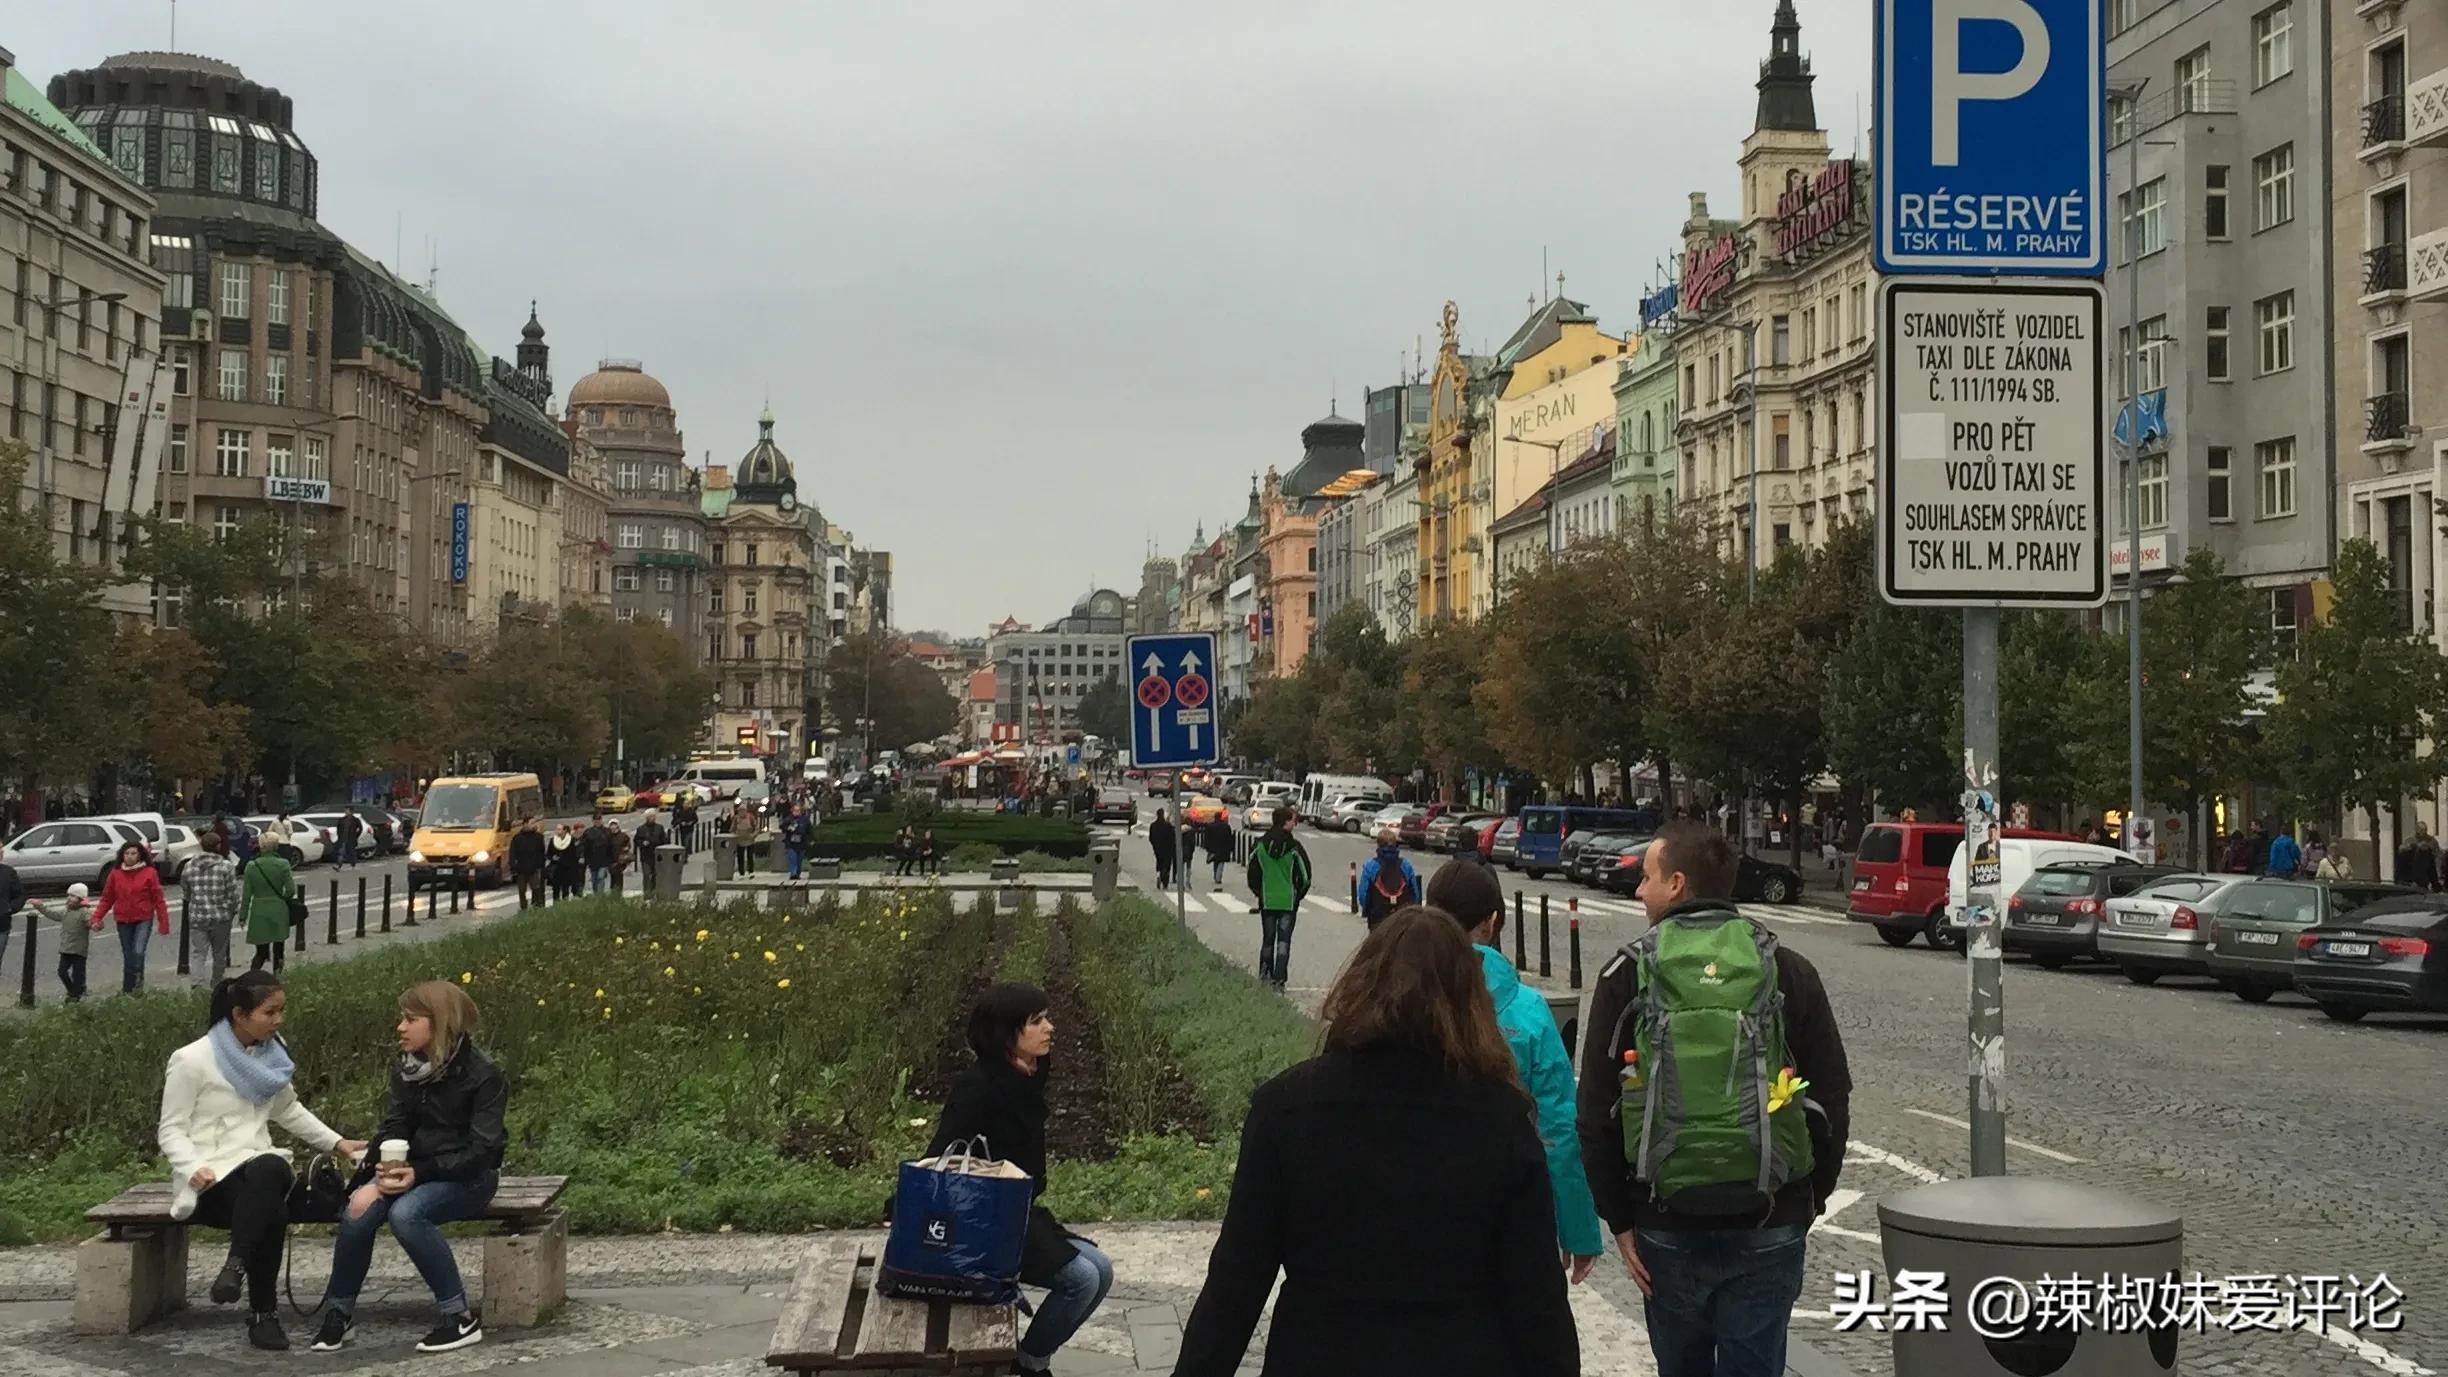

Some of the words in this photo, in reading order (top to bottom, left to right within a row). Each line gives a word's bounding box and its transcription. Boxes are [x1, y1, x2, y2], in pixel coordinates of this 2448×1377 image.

[1932, 0, 2051, 167] P
[1900, 187, 2083, 231] RÉSERVÉ
[1900, 232, 1939, 251] TSK
[1947, 233, 1978, 252] HL.
[1986, 234, 2007, 252] M.
[2016, 234, 2082, 254] PRAHY
[1904, 308, 2006, 339] STANOVIŠTĚ
[2016, 314, 2085, 340] VOZIDEL
[1917, 345, 1953, 370] TAXI
[1964, 346, 1995, 370] DLE
[2005, 342, 2072, 371] ZÁKONA
[1929, 372, 1945, 402] Č.
[1951, 377, 2027, 402] 111/1994
[2032, 378, 2060, 403] SB.
[1510, 393, 1575, 437] MERAN
[1953, 421, 1993, 451] PRO
[2001, 416, 2036, 452] PĚT
[1945, 454, 1996, 491] VOZŮ
[2001, 462, 2045, 491] TAXI
[2052, 464, 2076, 491] SE
[1905, 504, 2006, 531] SOUHLASEM
[2011, 499, 2087, 531] SPRÁVCE
[455, 508, 465, 580] ROKOKO
[1908, 540, 1945, 569] TSK
[1952, 541, 1982, 570] HL.
[1987, 541, 2012, 570] M.
[2016, 541, 2082, 572] PRAHY
[2110, 549, 2130, 565] otel
[898, 1283, 926, 1294] VAN
